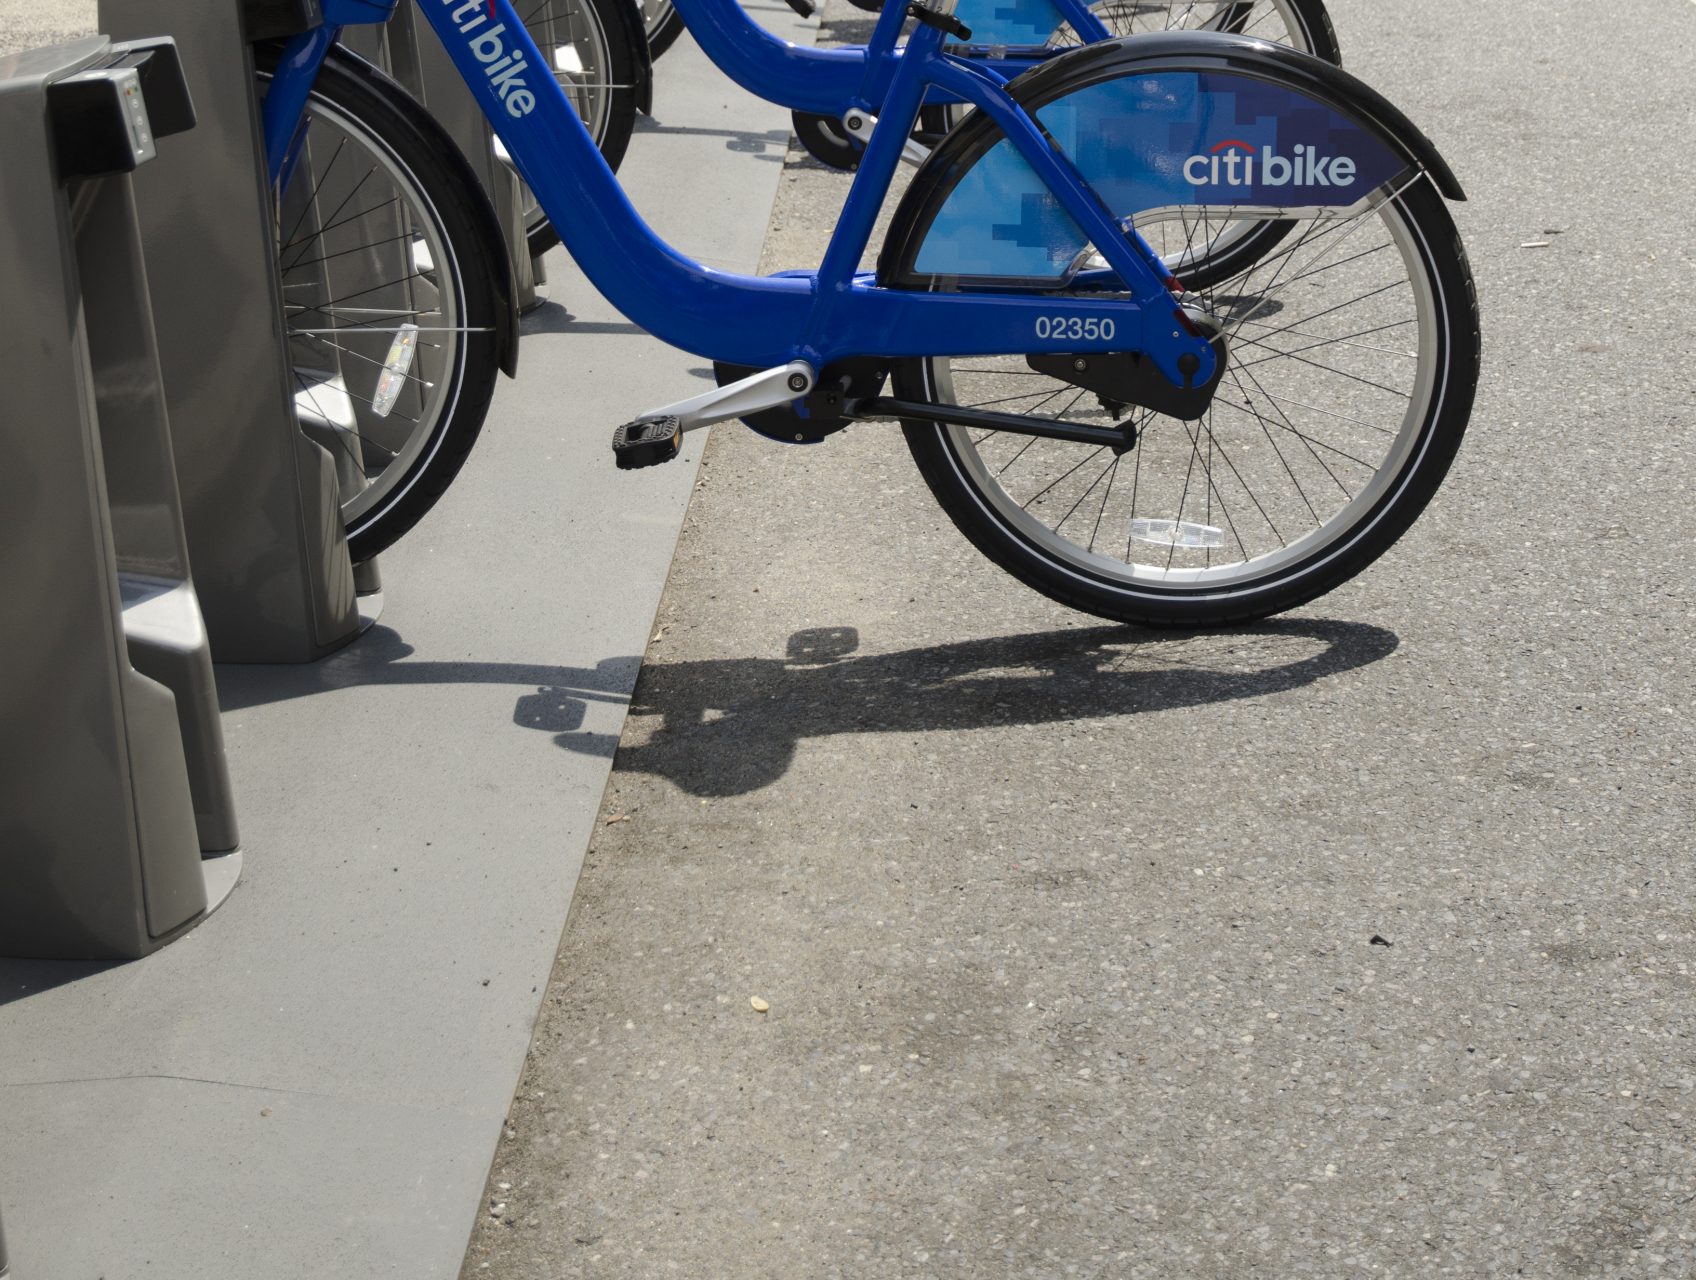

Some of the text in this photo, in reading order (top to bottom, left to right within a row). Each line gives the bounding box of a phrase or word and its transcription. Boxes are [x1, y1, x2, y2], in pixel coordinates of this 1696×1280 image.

[468, 22, 536, 119] bike
[1183, 140, 1356, 187] citi bike
[1035, 317, 1115, 341] 02350
